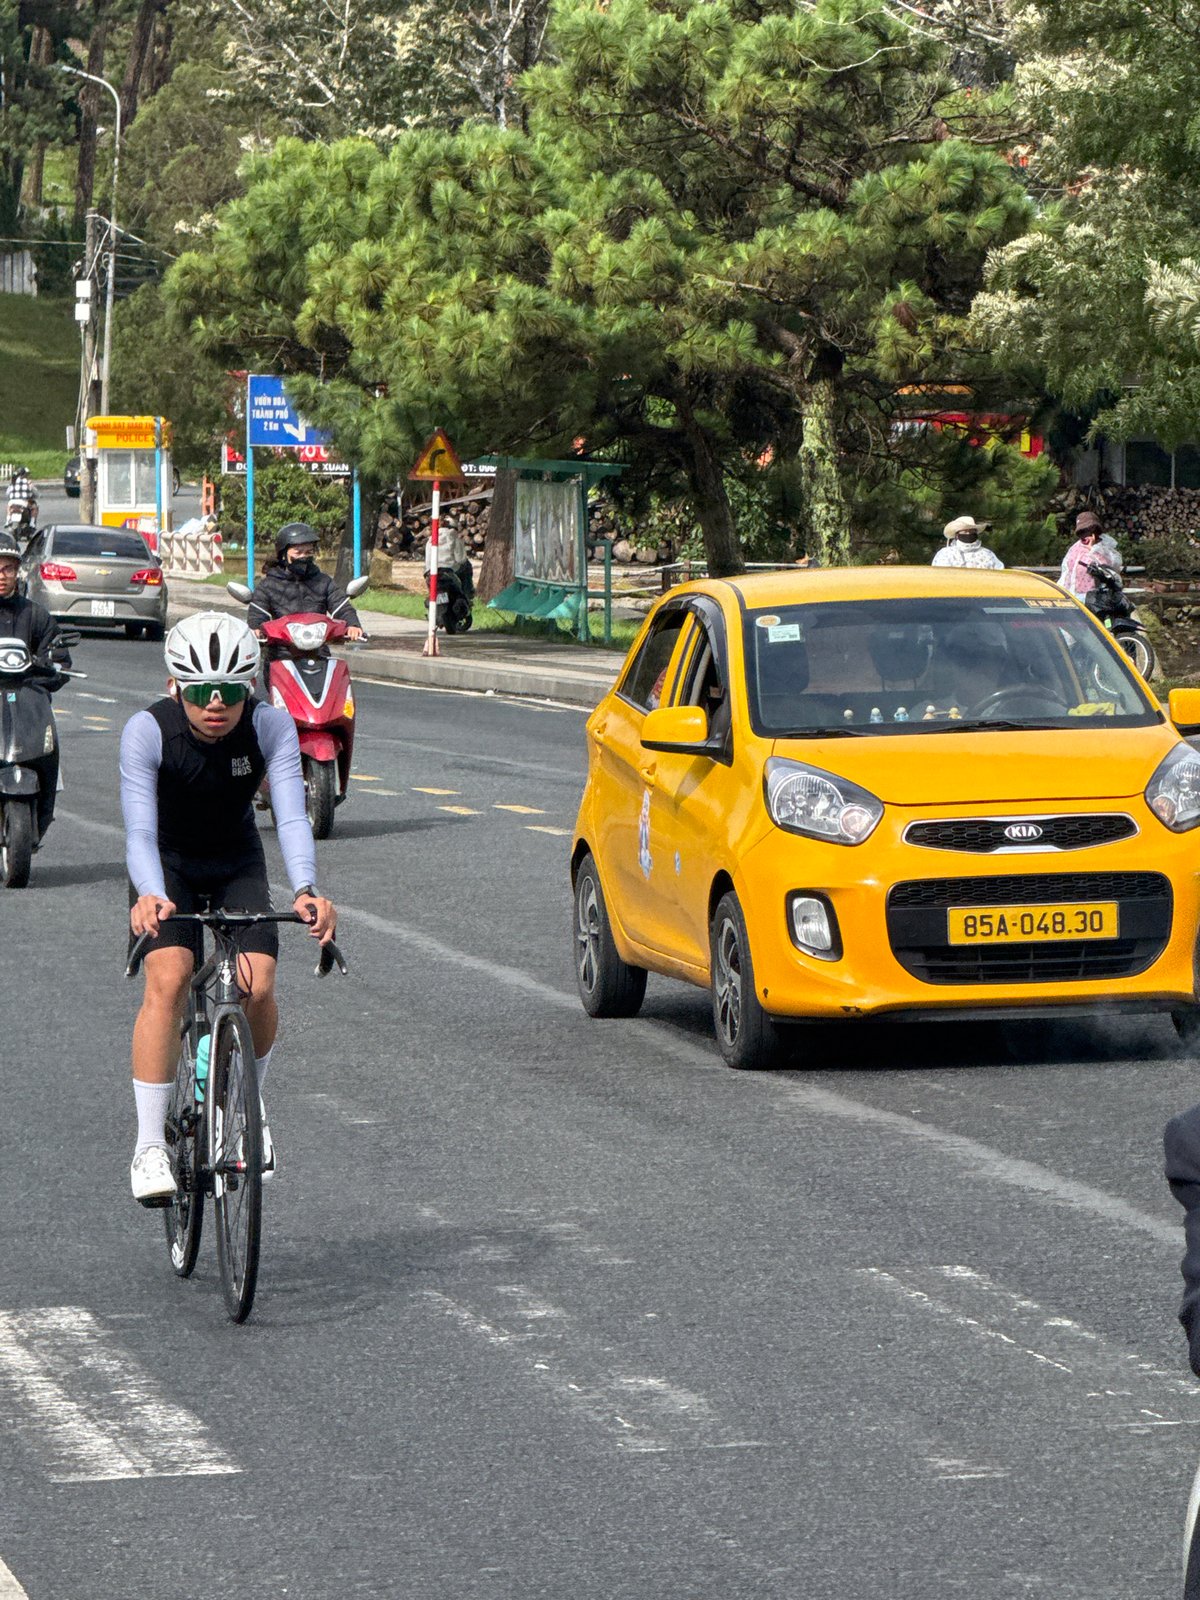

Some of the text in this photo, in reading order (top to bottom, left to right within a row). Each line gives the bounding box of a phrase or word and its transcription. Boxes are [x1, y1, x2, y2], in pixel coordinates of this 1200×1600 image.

[263, 421, 269, 431] 2
[116, 432, 150, 443] POLICE
[1011, 827, 1037, 837] KIA
[964, 910, 1103, 937] 85A-048.30
